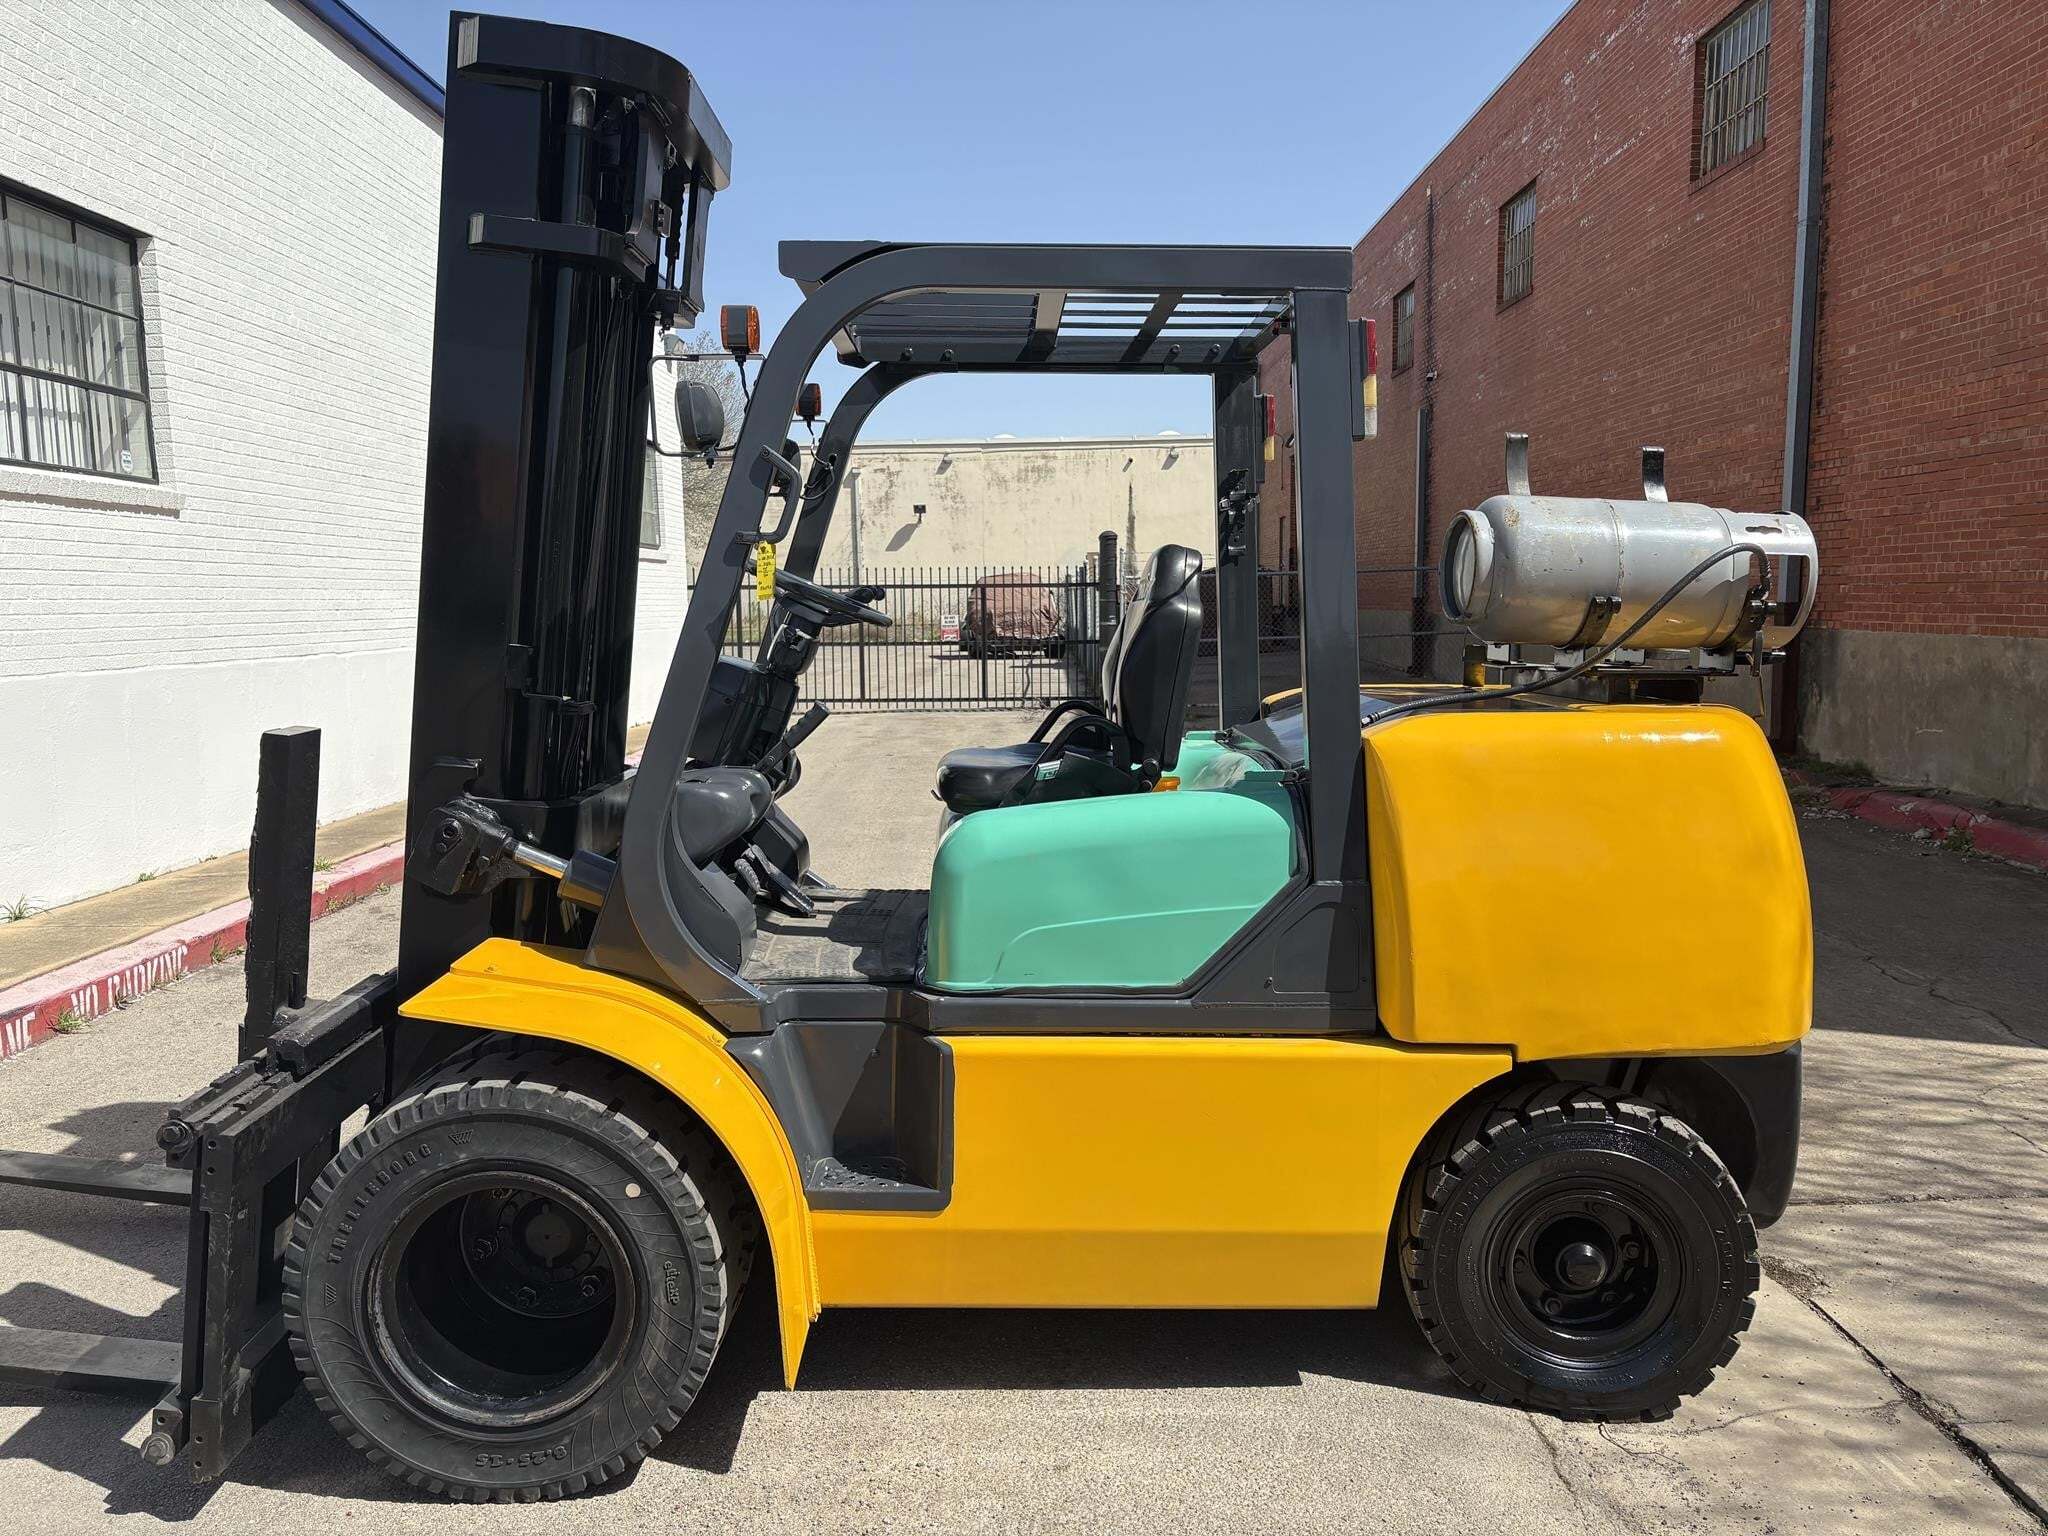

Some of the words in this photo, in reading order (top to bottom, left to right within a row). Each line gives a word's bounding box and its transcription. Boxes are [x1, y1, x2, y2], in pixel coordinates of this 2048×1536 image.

[0, 1011, 36, 1059] NE
[70, 984, 99, 1020] NO
[107, 944, 189, 1009] PARKING
[327, 1143, 433, 1264] TRELLEBORG
[475, 1445, 568, 1468] 8.25-15
